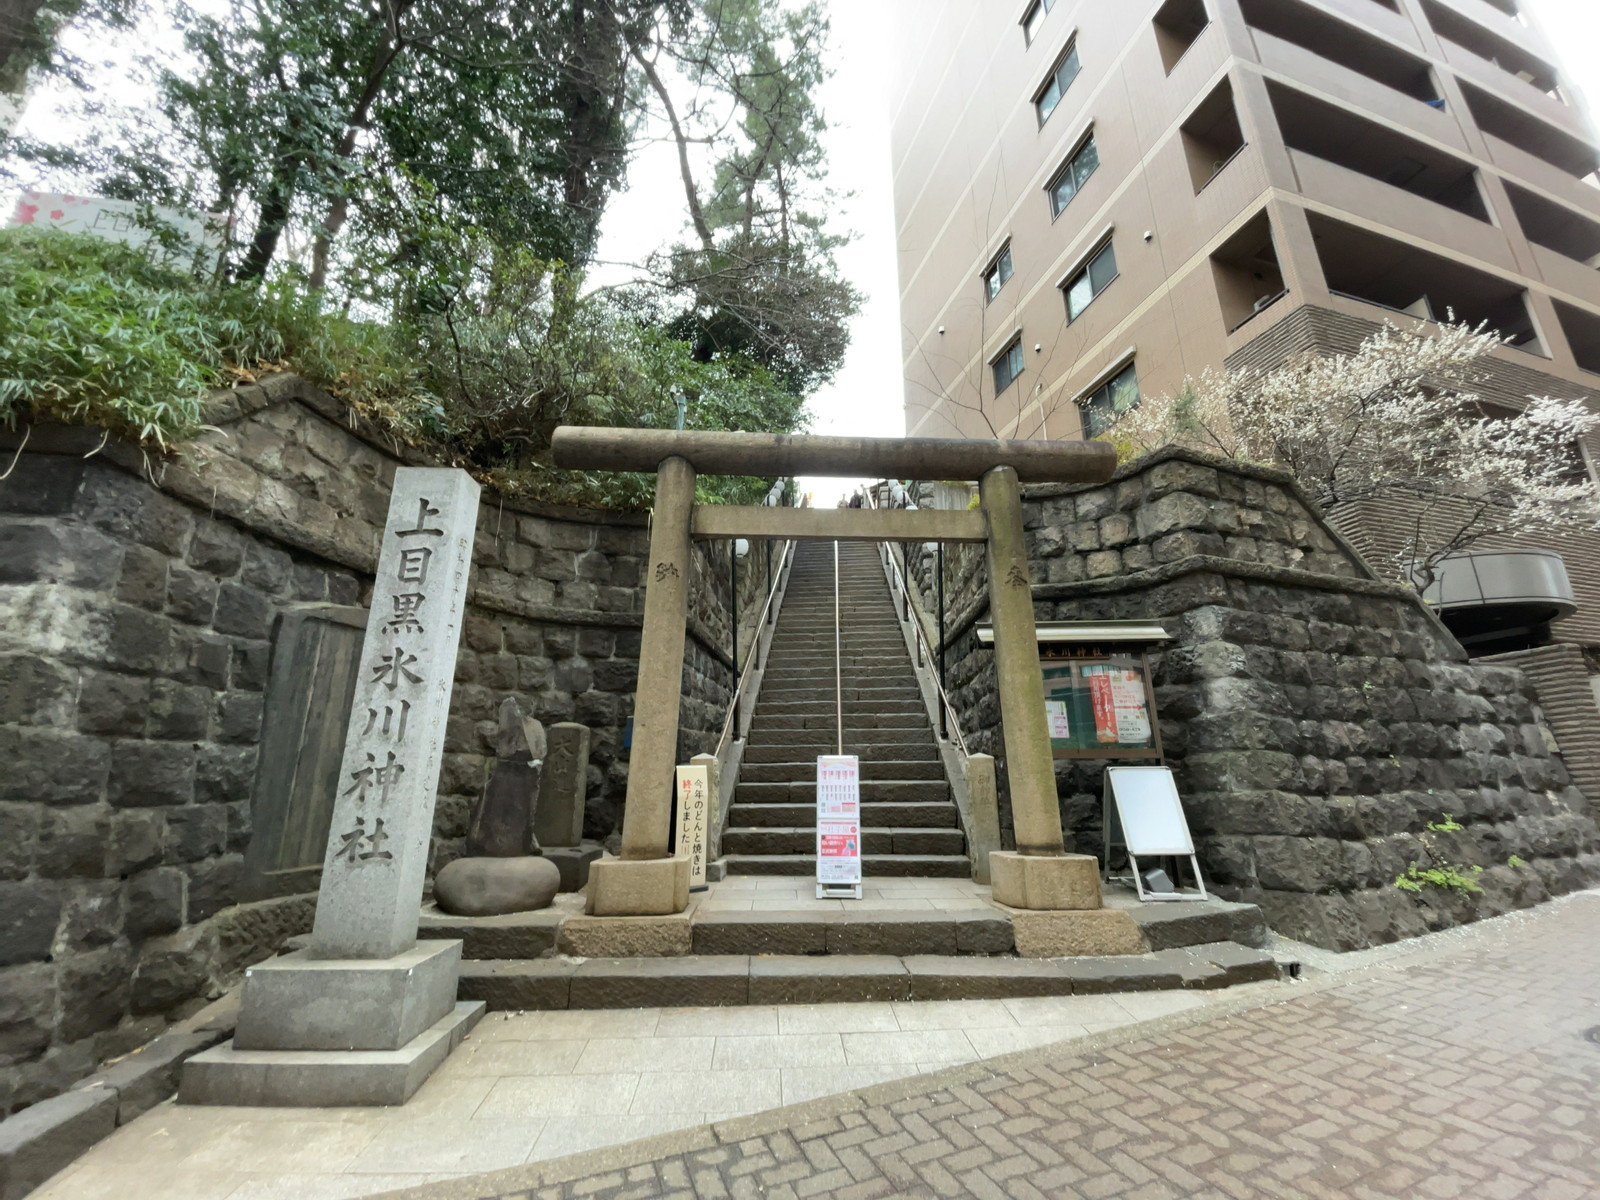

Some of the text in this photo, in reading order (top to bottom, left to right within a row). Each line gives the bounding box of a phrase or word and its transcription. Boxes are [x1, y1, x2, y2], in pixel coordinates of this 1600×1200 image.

[334, 497, 444, 863] 上目黒氷川神社
[692, 779, 705, 876] 今年のどんと焼きは
